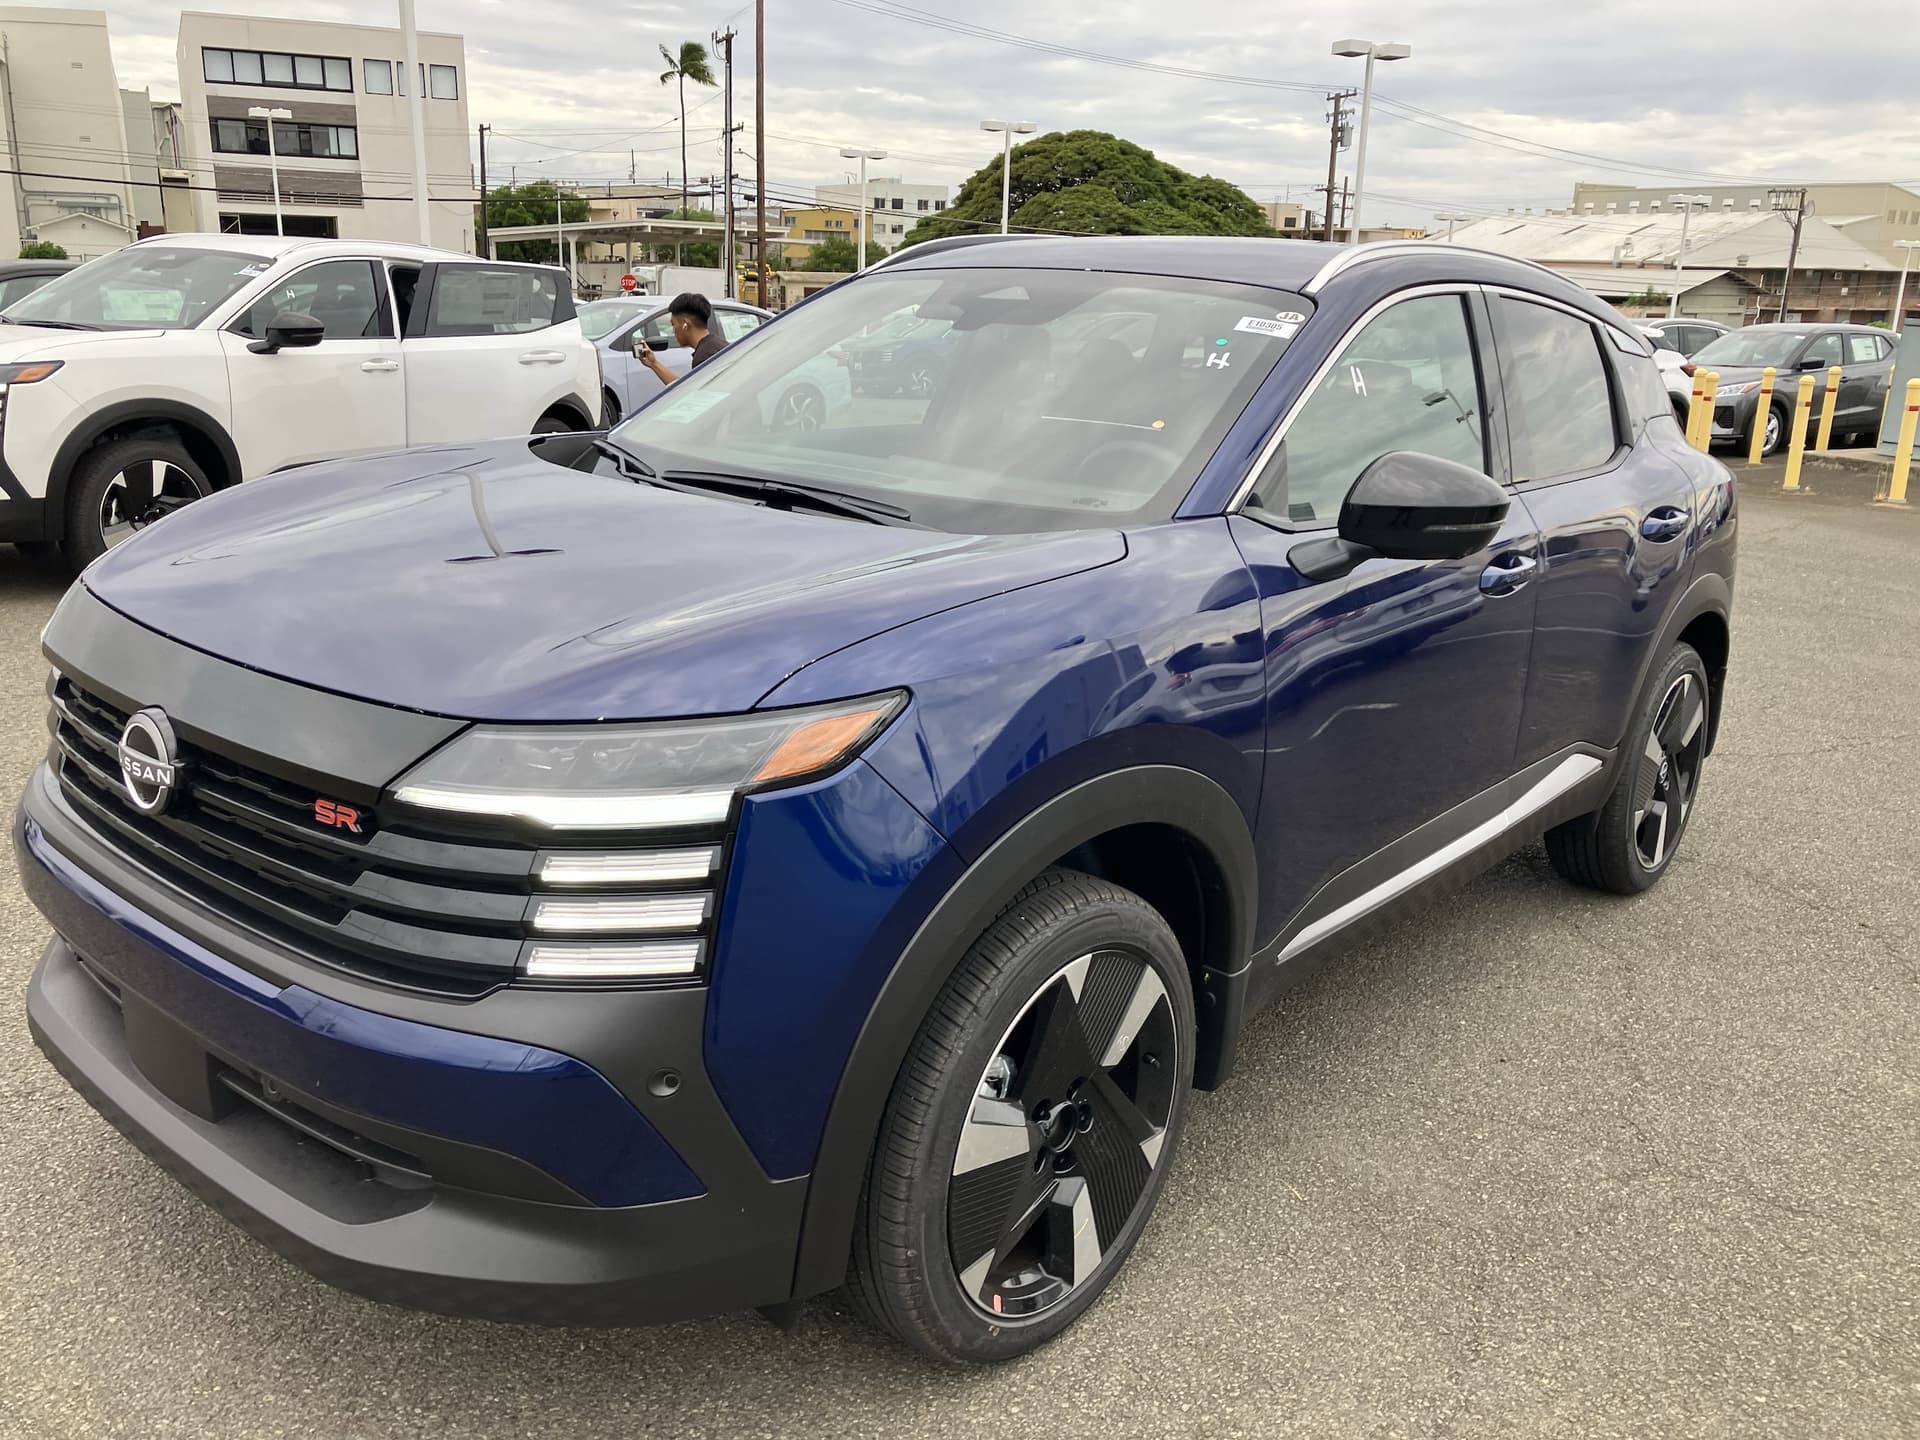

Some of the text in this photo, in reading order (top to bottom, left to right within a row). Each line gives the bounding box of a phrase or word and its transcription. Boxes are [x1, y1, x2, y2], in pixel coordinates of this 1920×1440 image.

[621, 279, 636, 287] STOP
[1279, 312, 1300, 321] JA
[120, 756, 171, 785] SSAN
[315, 799, 362, 832] SR
